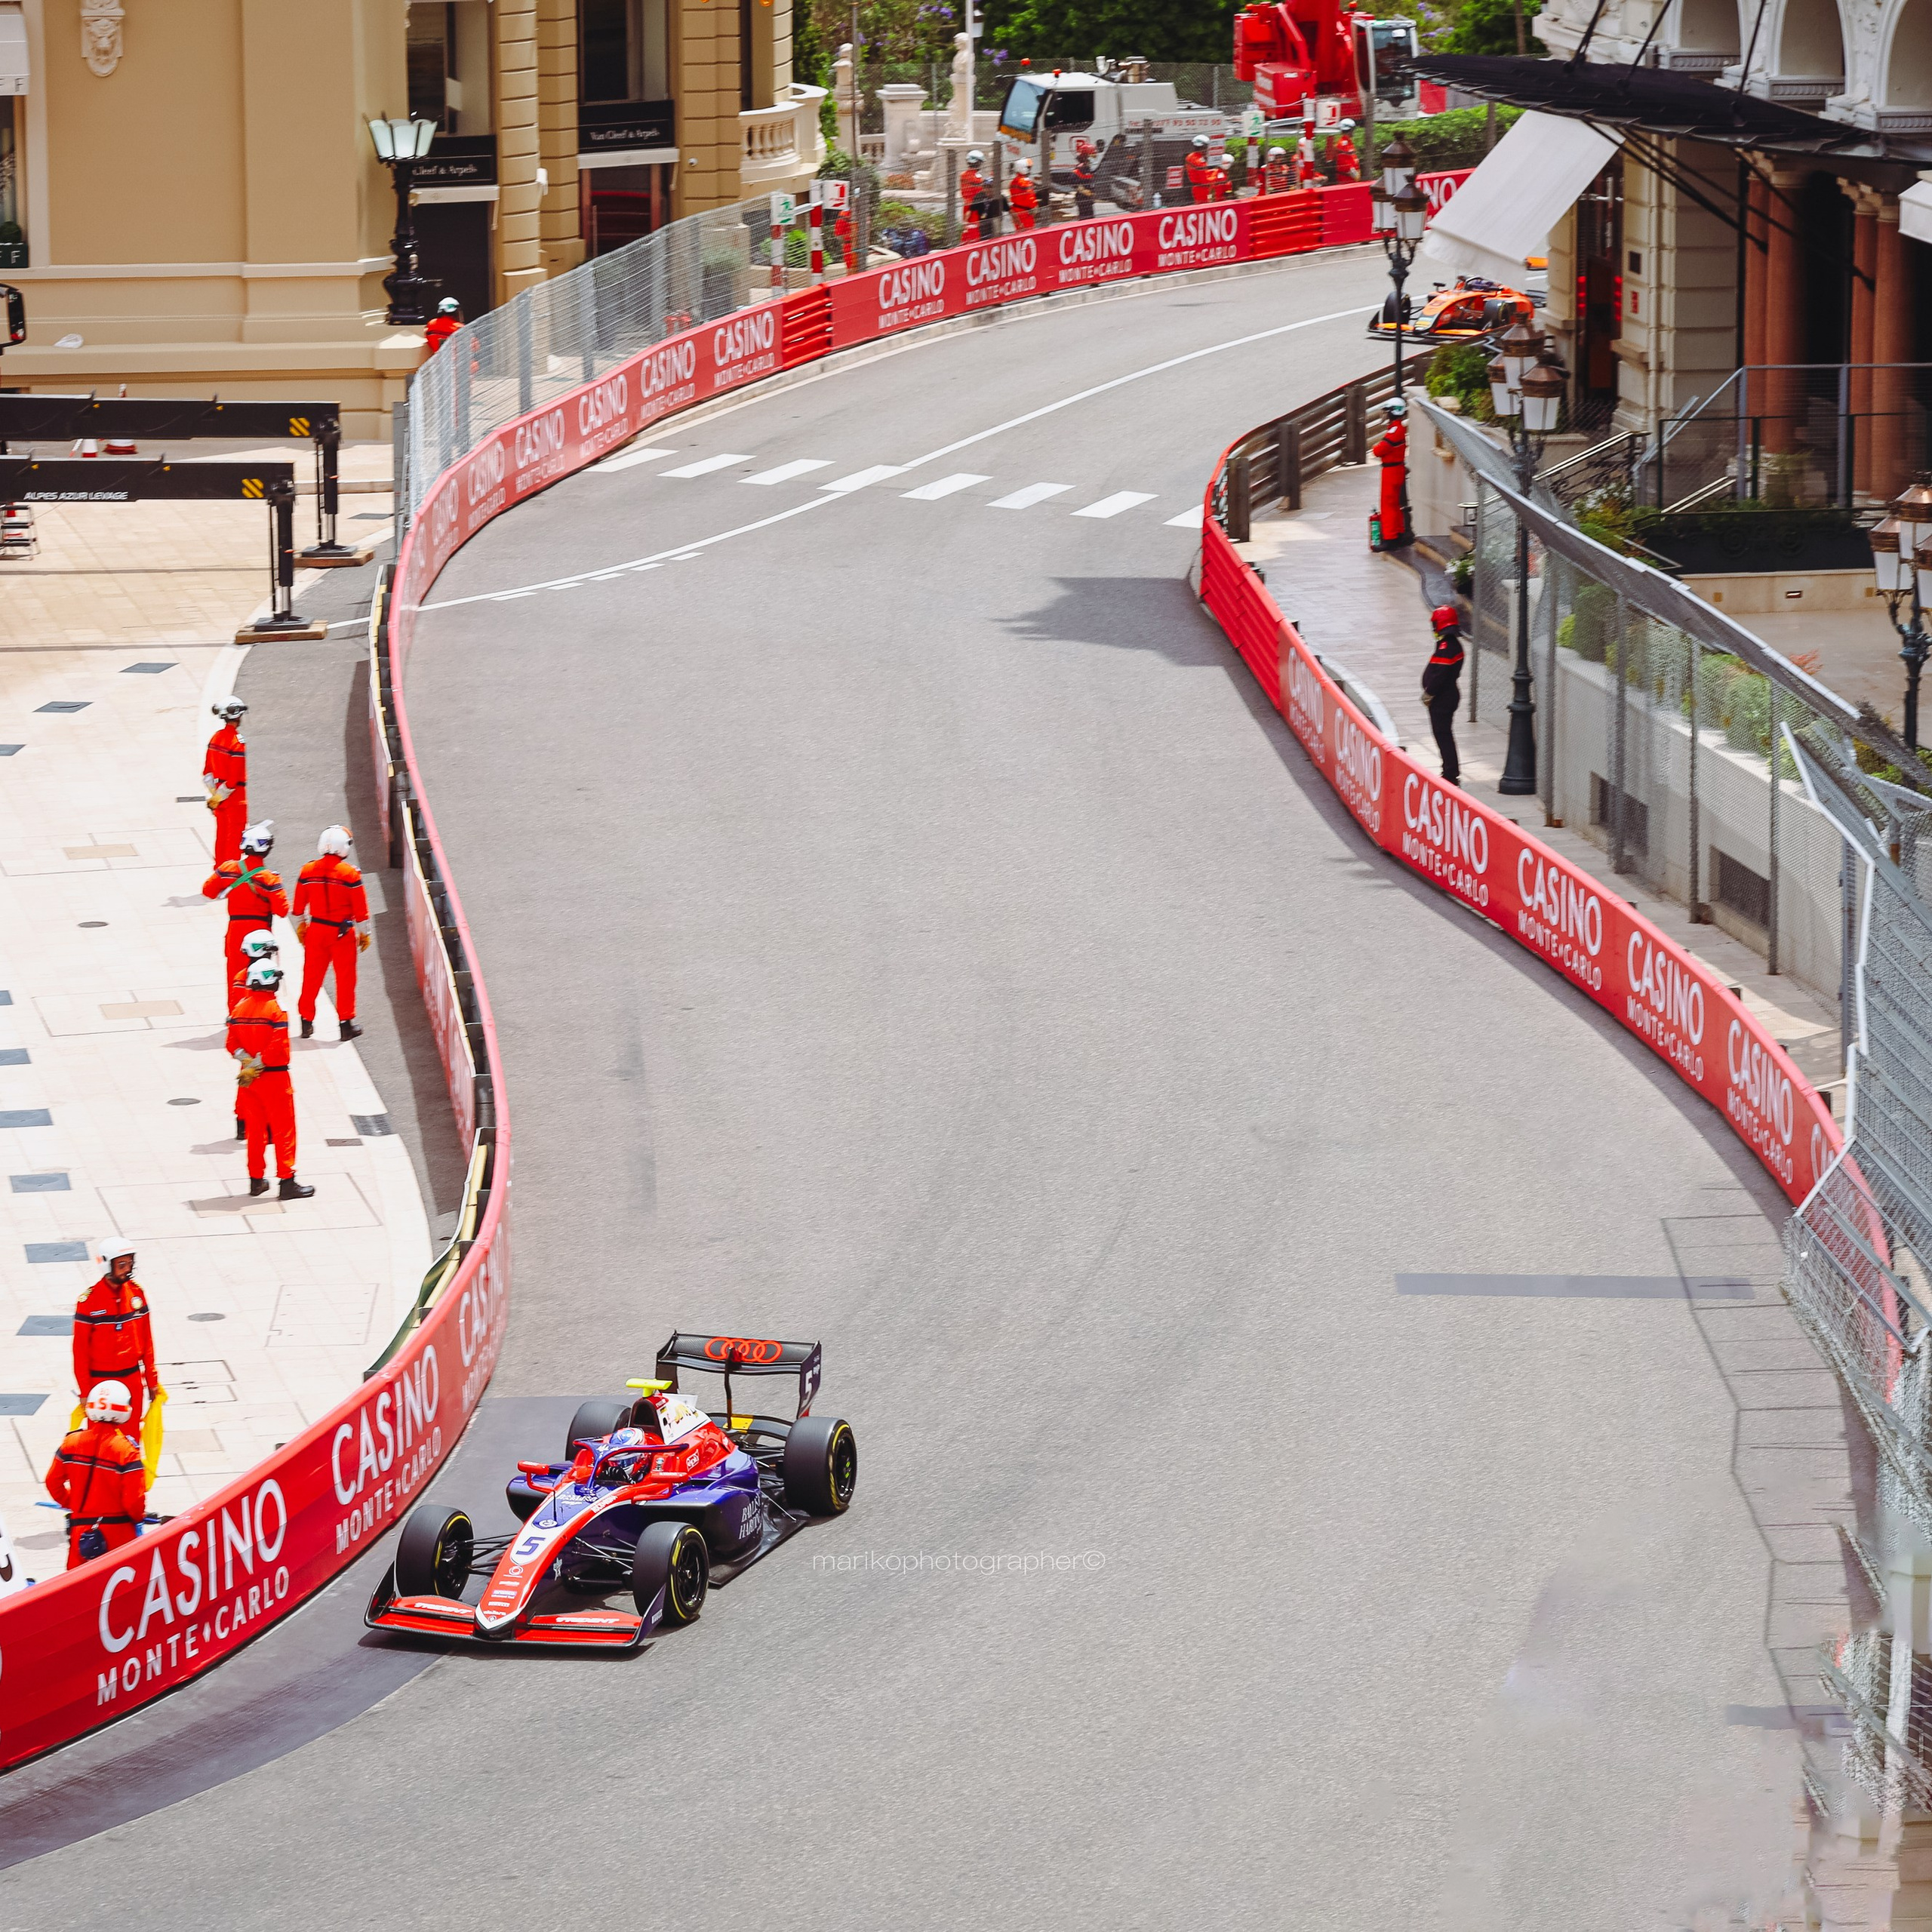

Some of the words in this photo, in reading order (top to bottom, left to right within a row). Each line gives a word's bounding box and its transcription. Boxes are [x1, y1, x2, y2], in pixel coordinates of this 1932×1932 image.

[1059, 221, 1134, 264] CASINO
[1158, 208, 1238, 250] CASINO
[1158, 250, 1195, 267] MONTE
[1200, 245, 1237, 262] CARLO
[878, 260, 945, 309] CASINO
[966, 284, 999, 305] MONTE
[1004, 276, 1036, 297] CARLO
[967, 238, 1037, 286] CASINO
[1059, 266, 1094, 283] MONTE
[1099, 258, 1132, 277] CARLO
[714, 311, 774, 367] CASINO
[878, 308, 909, 329] MONTE
[913, 299, 944, 319] CARLO
[641, 340, 696, 398] CASINO
[578, 374, 628, 436] CASINO
[1334, 708, 1381, 801] CASINO
[1404, 773, 1488, 874] CASINO
[1403, 832, 1442, 876] MONTE
[1447, 863, 1488, 906] CARLO
[1518, 848, 1602, 956] CASINO
[1518, 909, 1558, 958] MONTE
[1564, 944, 1601, 991] CARLO
[1627, 931, 1704, 1045] CASINO
[1627, 995, 1663, 1046] MONTE
[1669, 1032, 1703, 1081] CARLO
[1727, 1019, 1793, 1146] CASINO
[801, 1370, 813, 1408] 5
[332, 1345, 439, 1506] CASINO
[336, 1479, 394, 1555] MONTE
[401, 1426, 441, 1494] CARLO
[99, 1478, 287, 1653] CASINO
[516, 1537, 546, 1555] 5
[97, 1623, 198, 1705] MONTE
[215, 1566, 289, 1638] CARLO
[414, 1602, 473, 1614] TRIDENT
